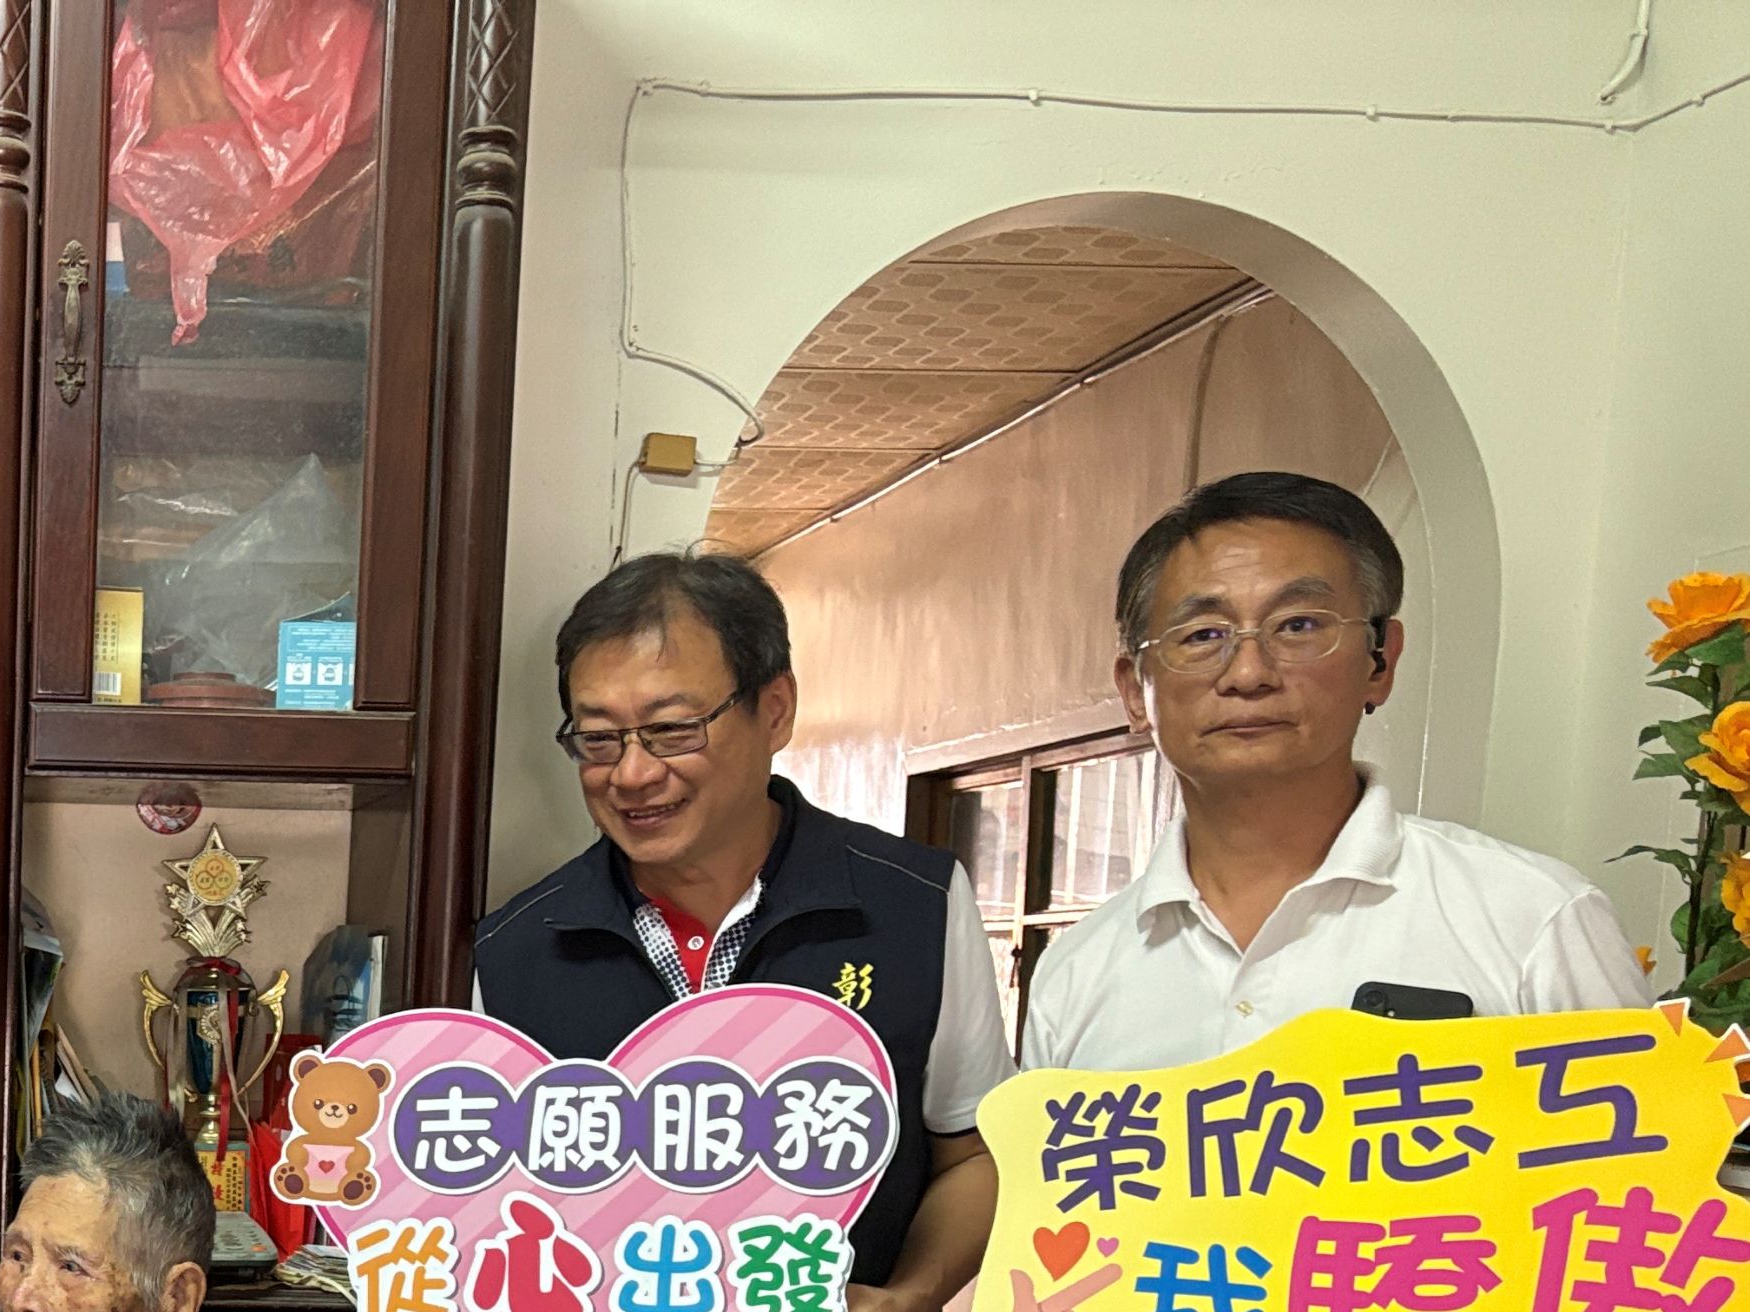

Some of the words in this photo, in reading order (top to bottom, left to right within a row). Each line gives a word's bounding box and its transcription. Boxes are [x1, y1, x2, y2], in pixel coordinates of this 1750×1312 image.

[832, 962, 874, 1010] 彰
[414, 1079, 874, 1174] 志願服務
[1042, 1034, 1668, 1211] 榮欣志工
